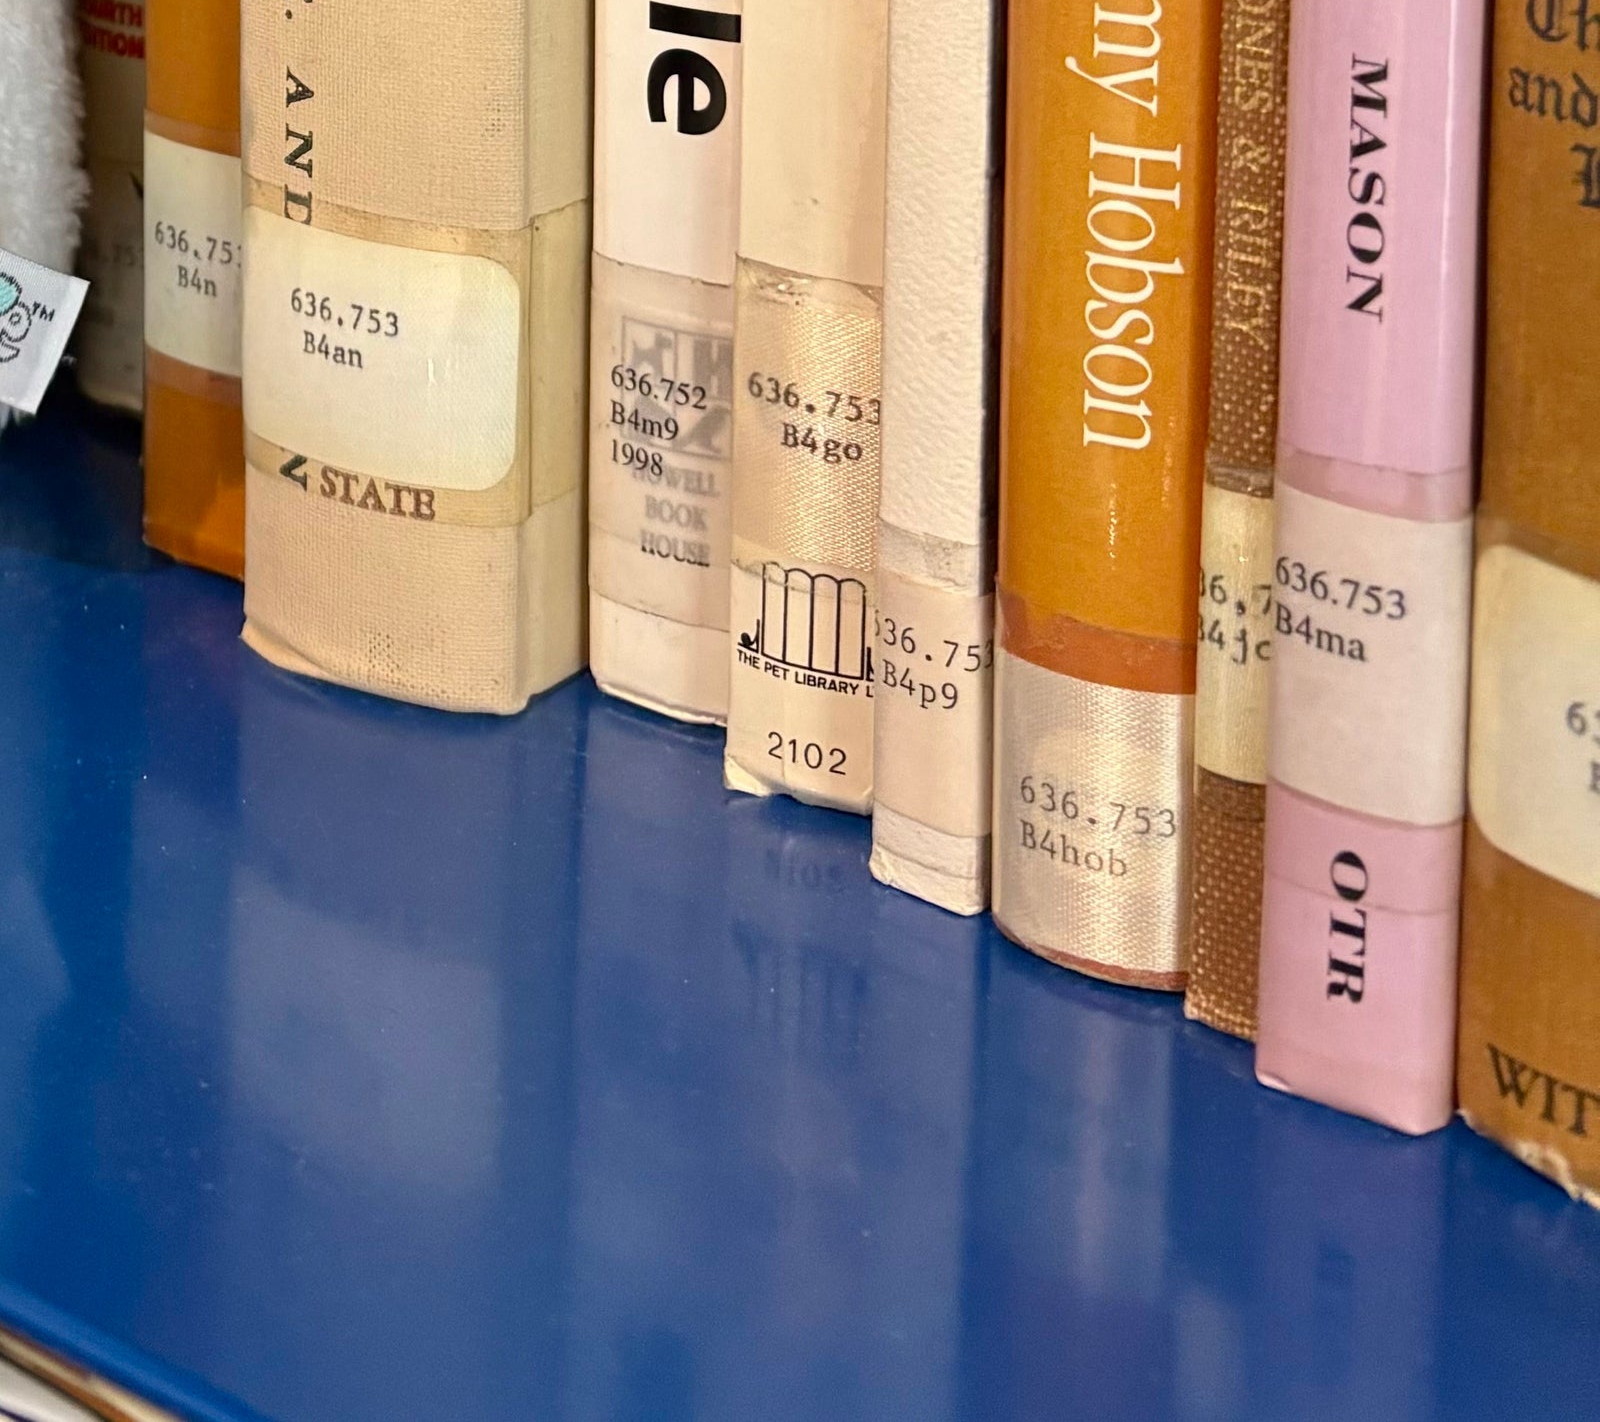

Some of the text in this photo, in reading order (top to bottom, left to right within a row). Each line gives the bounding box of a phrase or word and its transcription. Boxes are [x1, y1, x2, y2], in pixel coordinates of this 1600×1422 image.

[1509, 66, 1599, 128] and
[283, 67, 315, 226] AND
[1231, 137, 1270, 173] &
[1345, 52, 1389, 323] MASON
[155, 221, 241, 268] 636.75
[178, 265, 217, 297] B4n
[1082, 132, 1185, 453] Hobson
[1226, 198, 1270, 350] RILEY
[290, 288, 400, 337] 636.753
[303, 330, 364, 369] B4an
[611, 364, 707, 410] 636.752
[748, 371, 880, 425] 636.753
[610, 399, 679, 440] B4m9
[781, 421, 863, 464] B4go
[611, 439, 663, 476] 1998
[320, 465, 435, 521] STATE
[645, 493, 708, 531] BOOK
[640, 529, 711, 567] HOUSE
[1275, 556, 1407, 620] 636.753
[1275, 601, 1367, 662] B4ma
[737, 649, 760, 670] THE
[764, 661, 789, 681] PET
[795, 671, 859, 695] LIBRARY
[882, 659, 958, 709] B4p9
[768, 731, 846, 775] 2102
[1020, 775, 1177, 838] 636.753
[1020, 819, 1127, 877] B4hob
[1327, 850, 1370, 1005] OTR
[1486, 1043, 1600, 1137] WIT
